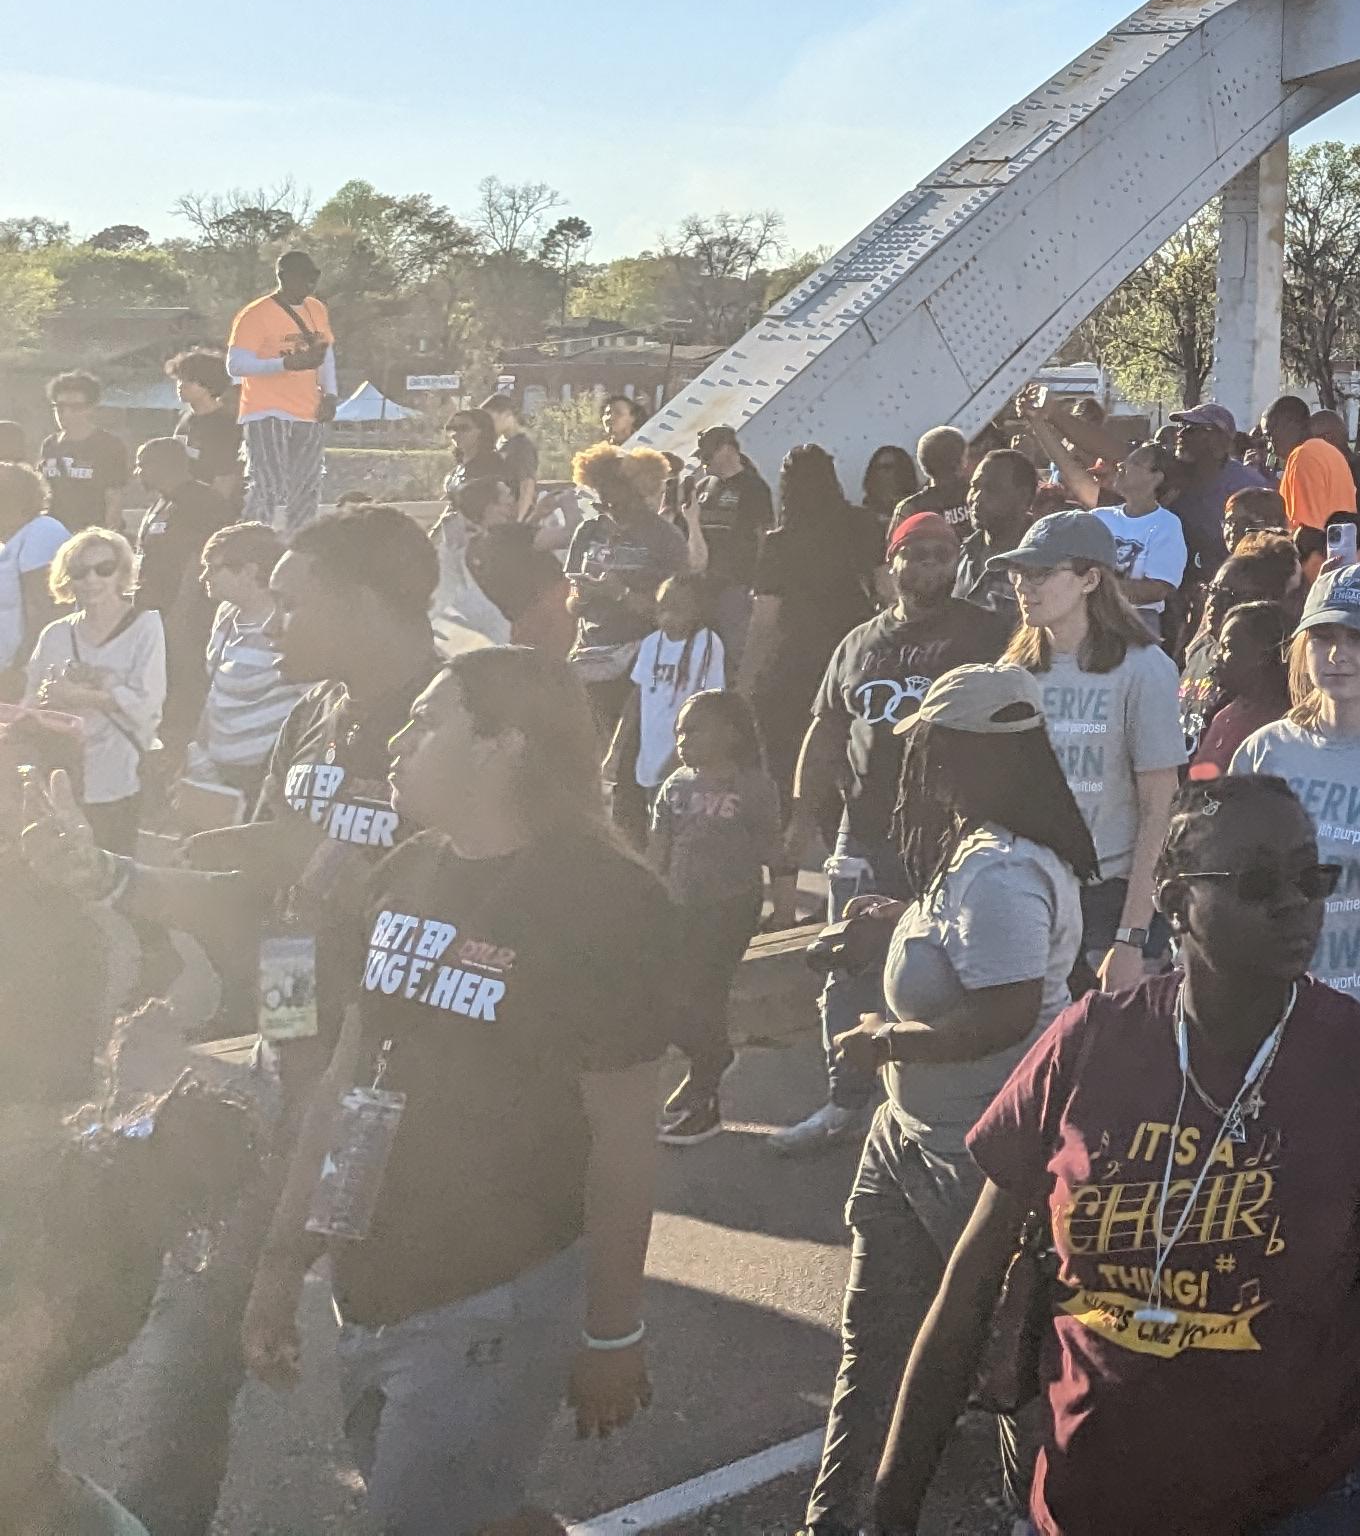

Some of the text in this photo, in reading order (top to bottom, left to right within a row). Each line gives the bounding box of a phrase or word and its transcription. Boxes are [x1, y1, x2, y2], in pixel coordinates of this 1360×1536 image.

[1043, 687, 1111, 721] ERVE
[1127, 1121, 1235, 1169] IT'S A
[1063, 1169, 1275, 1255] CHOIR
[1098, 1264, 1211, 1309] THING!
